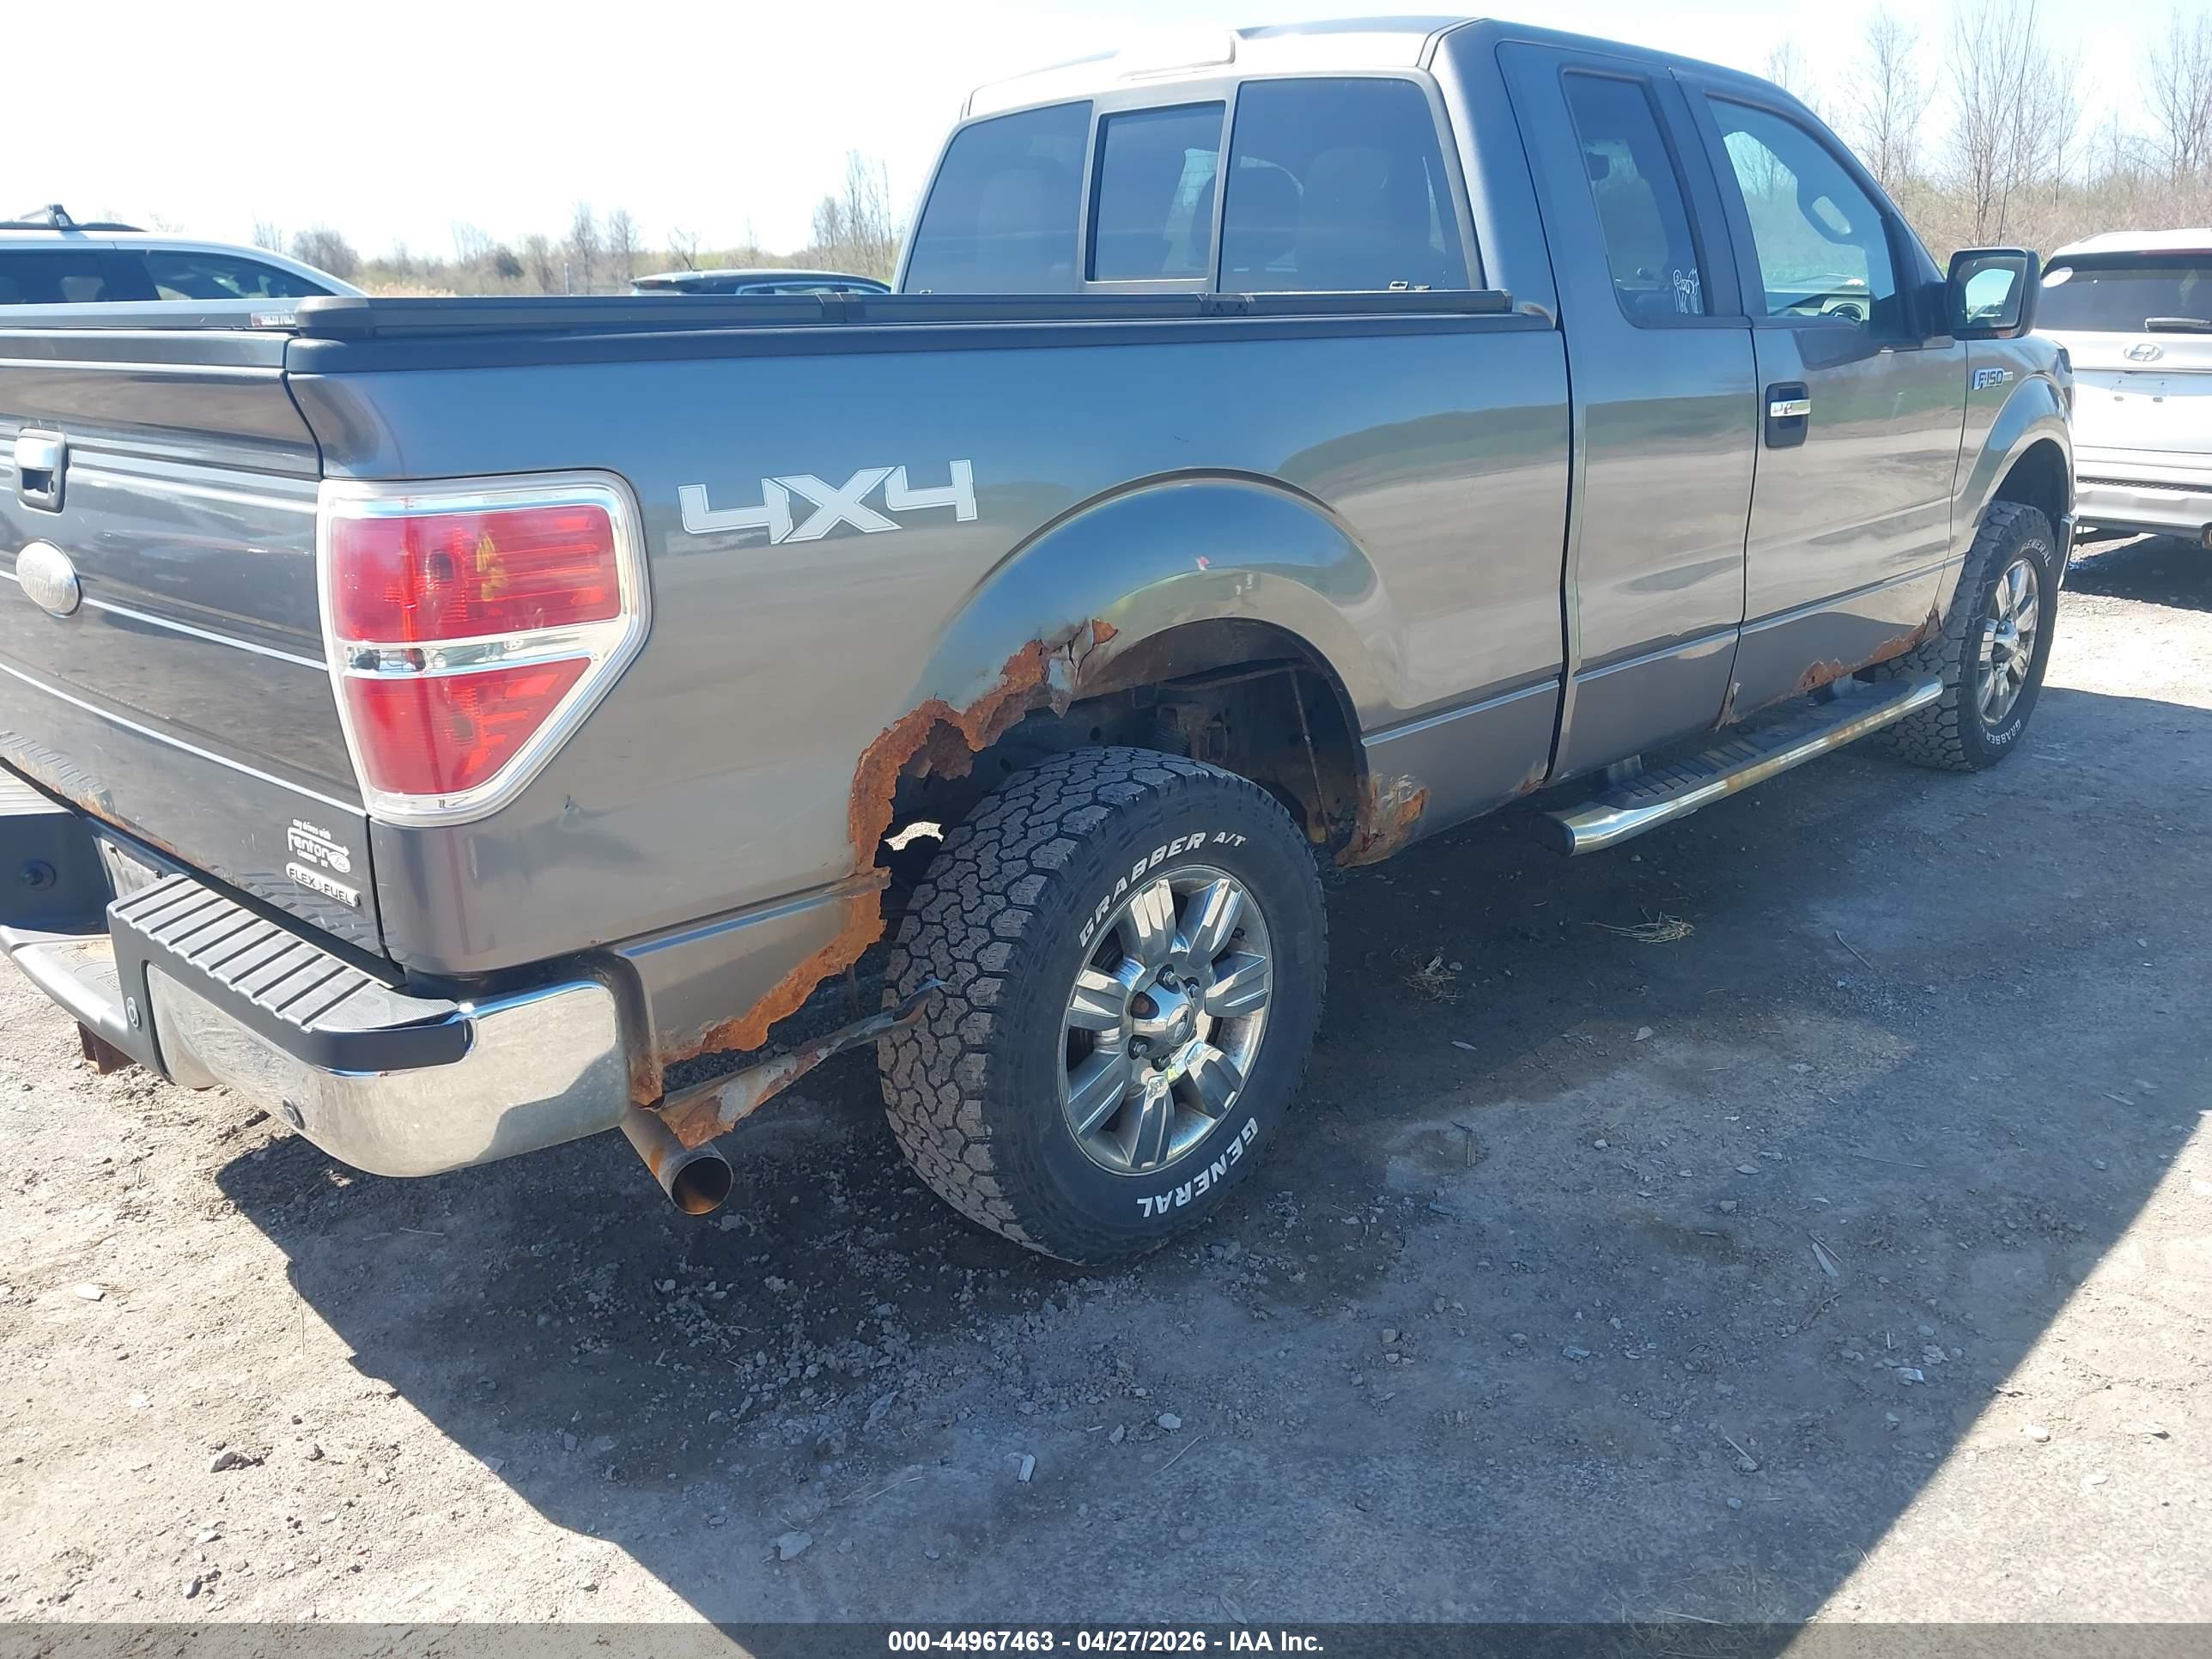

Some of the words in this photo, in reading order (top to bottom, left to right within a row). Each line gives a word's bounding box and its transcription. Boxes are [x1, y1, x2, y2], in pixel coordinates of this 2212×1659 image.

[1977, 369, 2005, 389] F-150
[2020, 538, 2051, 568] GENERAL
[1985, 718, 2021, 745] GRABBER
[319, 828, 331, 841] with
[289, 867, 317, 889] FLEX
[324, 883, 353, 906] FUEL
[1079, 832, 1206, 948] GRABBER
[1212, 831, 1246, 848] A/T
[1136, 1117, 1259, 1218] GENERAL
